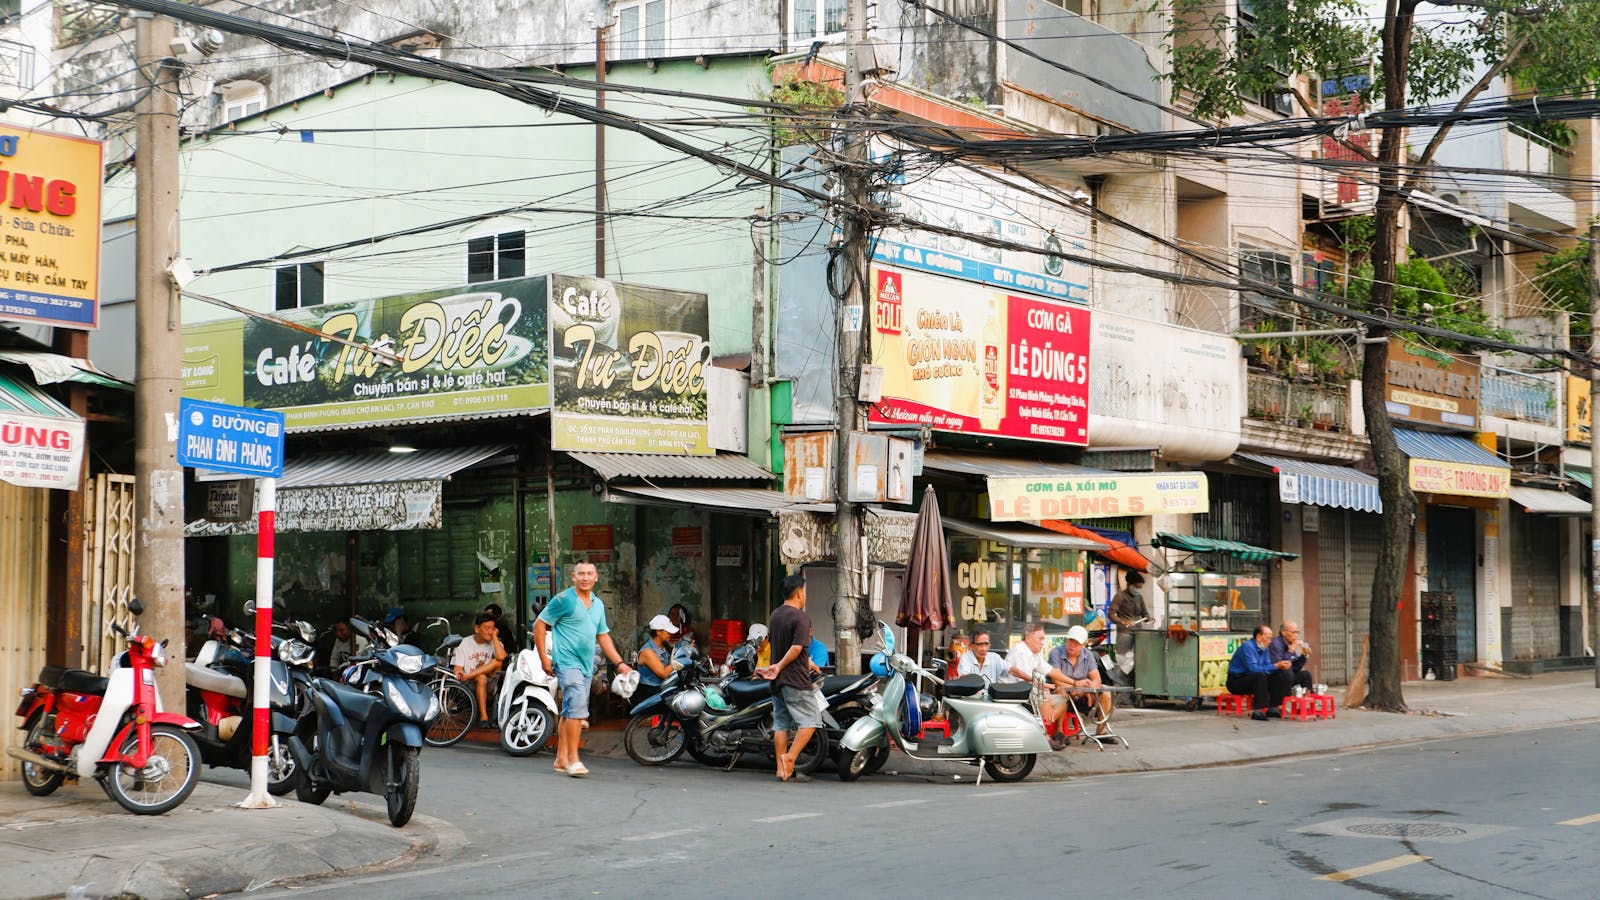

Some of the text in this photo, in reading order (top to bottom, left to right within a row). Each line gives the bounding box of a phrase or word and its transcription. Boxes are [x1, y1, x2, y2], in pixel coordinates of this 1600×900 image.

[0, 168, 76, 216] NG
[71, 278, 88, 291] TAY
[880, 292, 900, 302] MEIZAN
[563, 286, 612, 319] Café
[875, 301, 902, 331] GOLD
[1028, 308, 1054, 332] CƠM
[1056, 311, 1072, 335] GÀ
[256, 341, 316, 387] Café
[400, 299, 508, 374] Điếc
[564, 324, 705, 396] Tư Điếc
[1010, 338, 1086, 385] LÊ DŨNG 5
[354, 380, 394, 400] Chuyên
[396, 377, 418, 393] bán
[432, 376, 441, 389] &
[457, 370, 484, 387] café
[486, 368, 507, 387] hạt
[578, 397, 612, 410] Chuyên
[613, 399, 630, 411] bán
[212, 413, 266, 435] ĐƯỜNG
[945, 416, 964, 430] ngay
[187, 433, 272, 468] PHAN ĐÌNH PHÙNG
[1025, 482, 1053, 493] CƠM
[1057, 481, 1073, 492] GÀ
[995, 494, 1144, 518] LÊ DŨNG 5
[961, 590, 988, 621] GÀ
